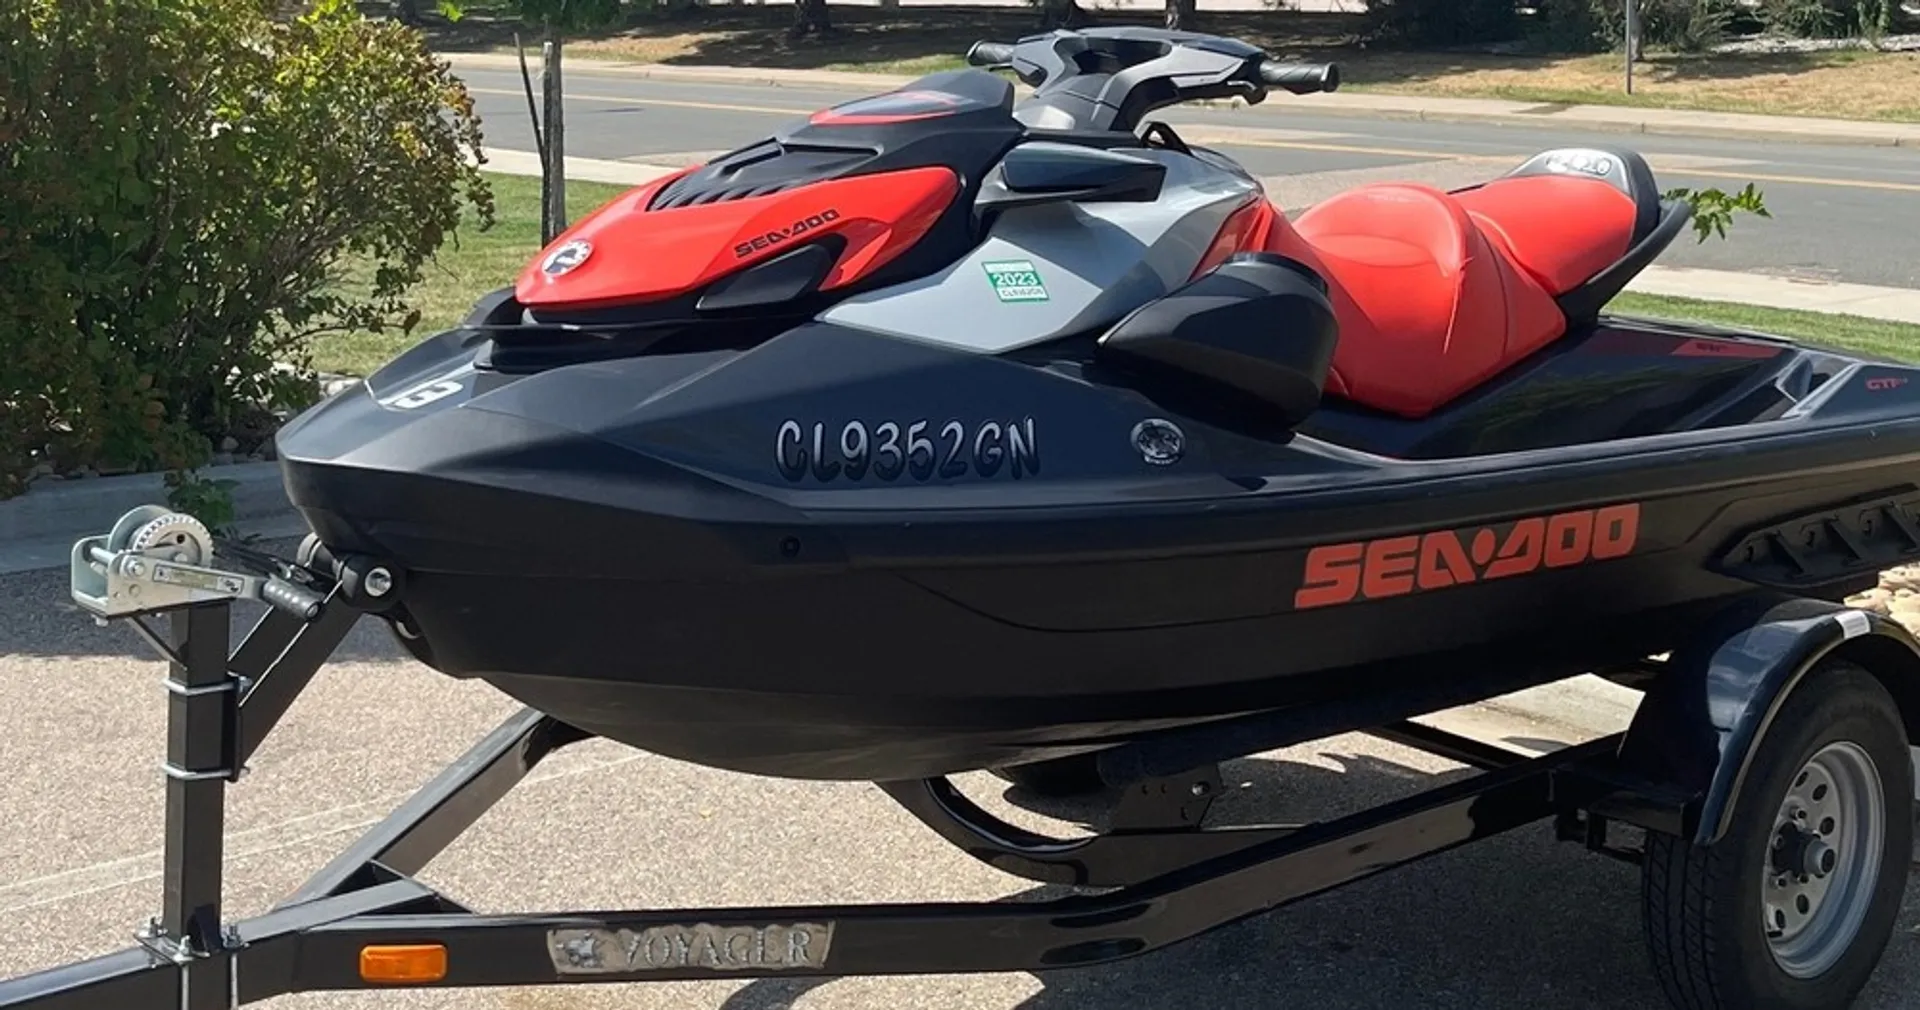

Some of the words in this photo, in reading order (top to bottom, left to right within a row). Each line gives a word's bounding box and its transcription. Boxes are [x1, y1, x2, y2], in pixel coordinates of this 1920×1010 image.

[993, 271, 1038, 286] 2023
[775, 416, 1040, 482] CL9352GN
[620, 929, 810, 966] VOYAGER
